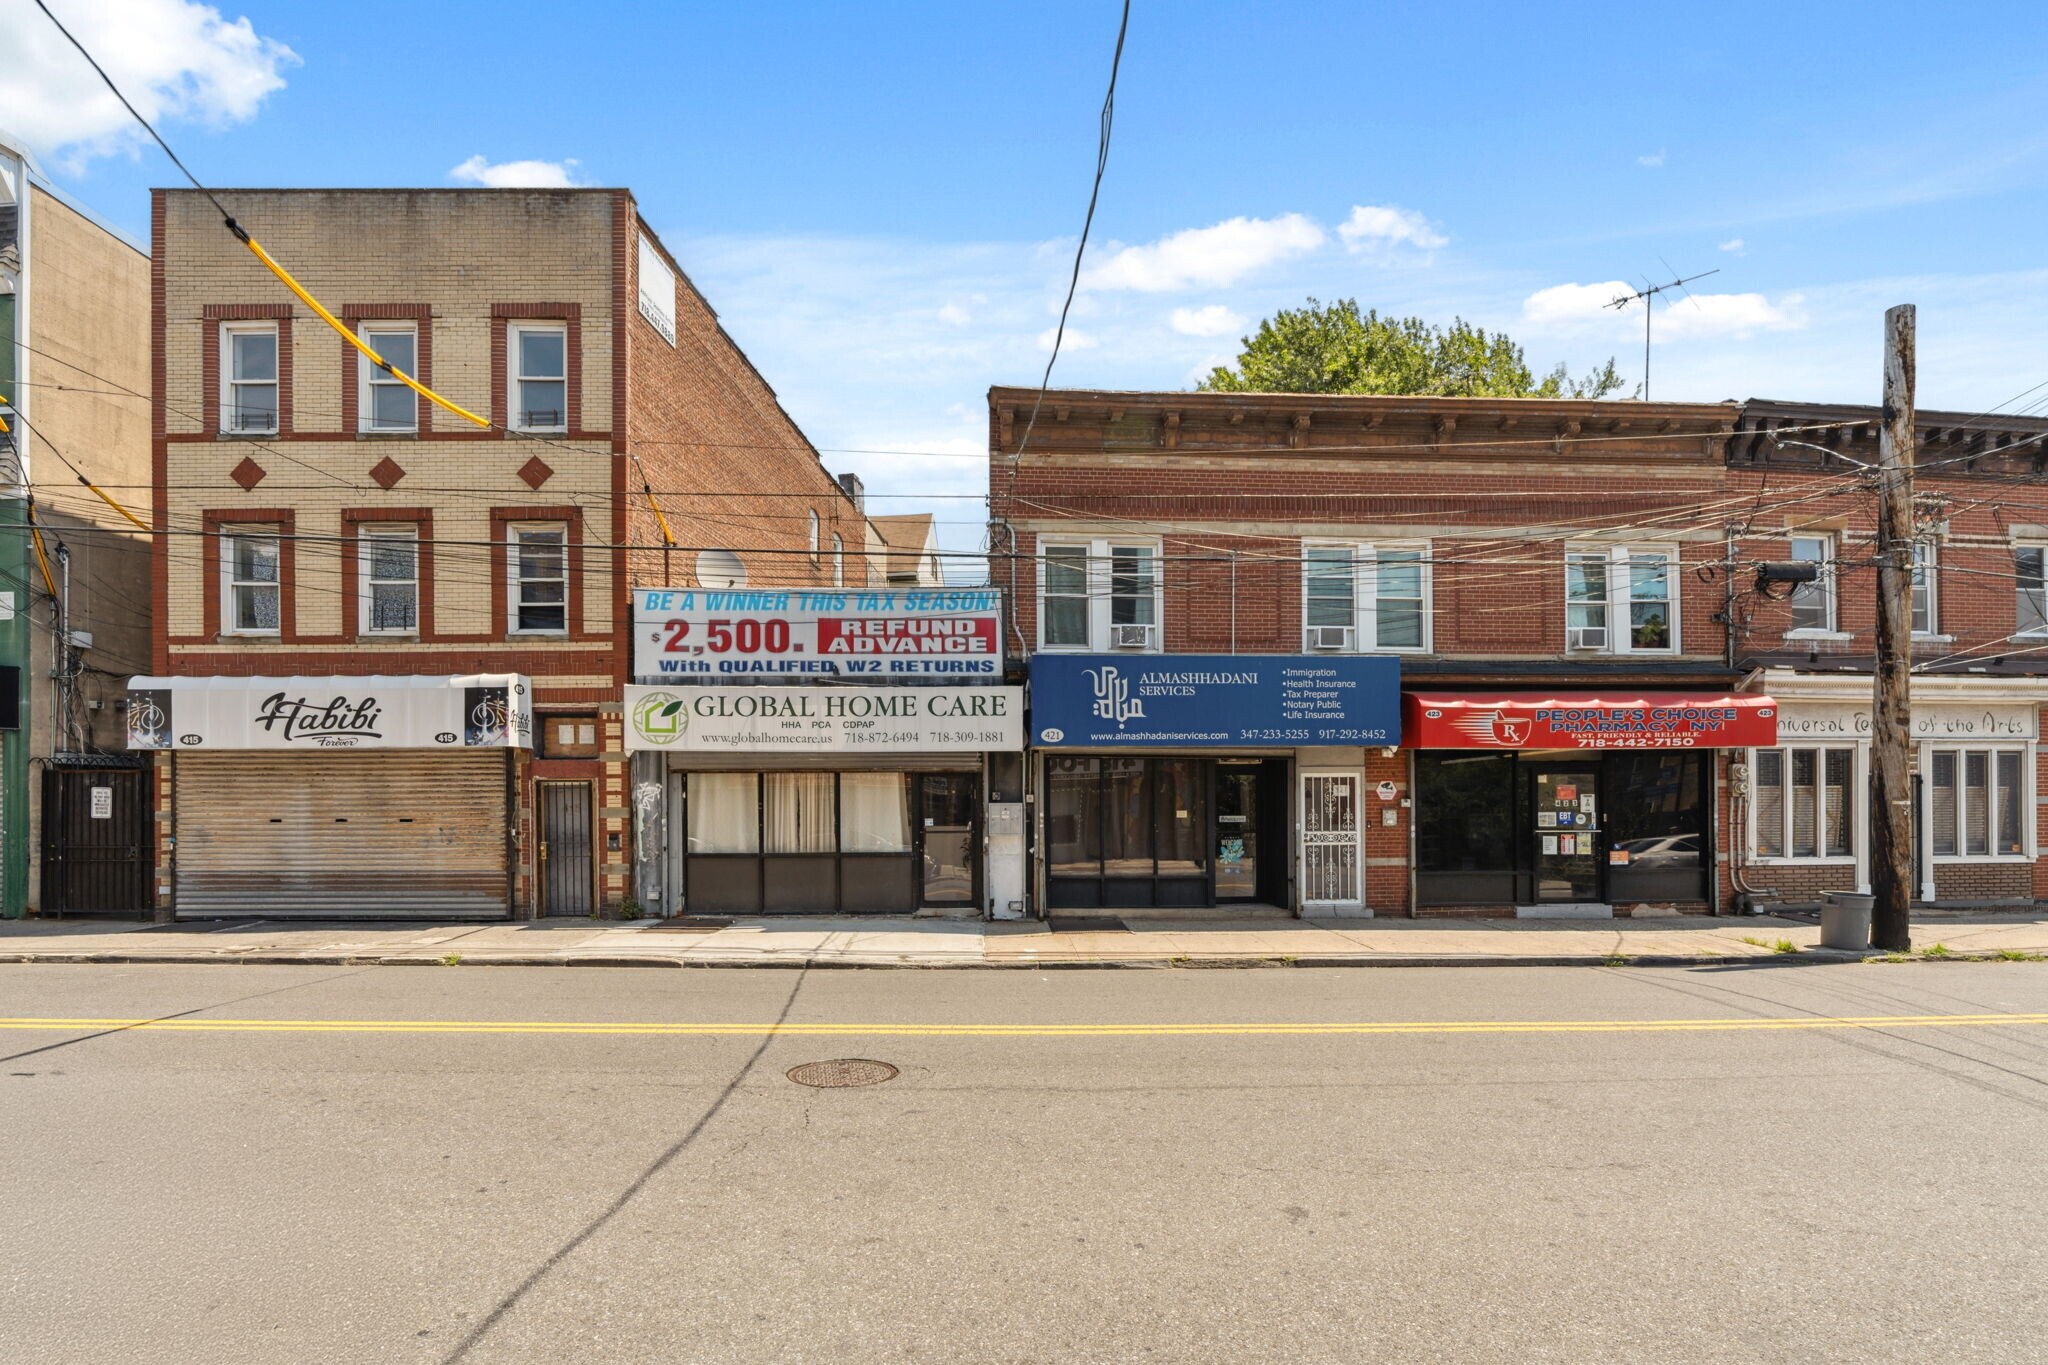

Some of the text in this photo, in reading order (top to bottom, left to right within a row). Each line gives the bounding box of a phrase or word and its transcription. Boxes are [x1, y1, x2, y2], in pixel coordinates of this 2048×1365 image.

[645, 592, 999, 612] BE A WINNER THIS TAX SEASON!
[840, 620, 976, 635] REFUND
[828, 636, 987, 654] ADVANCE
[659, 660, 994, 674] With QUALIFIED W2 RETURNS
[1287, 668, 1336, 678] Immigration
[1139, 672, 1258, 685] ALMASHHADANI
[1287, 680, 1356, 688] Health Insurance
[1139, 686, 1196, 696] SERVICES
[1304, 690, 1338, 700] Preparer
[694, 695, 1007, 718] GLOBAL HOME CARE
[1287, 700, 1341, 710] Notary Public
[255, 692, 382, 740] Habibi
[1536, 708, 1737, 722] PEOPLE'S CHOICE
[1549, 721, 1722, 732] PHARMACY NY
[1777, 714, 1844, 732] niversal
[1918, 715, 1936, 732] of
[1982, 712, 2022, 733] Arts
[438, 733, 454, 743] 415
[702, 732, 1004, 746] www.globalhomecare.us 718-872-6494 718-309-1881
[1044, 731, 1061, 740] 421
[1091, 732, 1228, 740] www.almashhadaniservices.com
[1240, 729, 1386, 739] 347-233-5255 917-292-8452
[183, 735, 199, 744] 415
[312, 736, 358, 747] Forever
[1578, 738, 1694, 747] 718-442-7150
[1560, 812, 1572, 820] EBT
